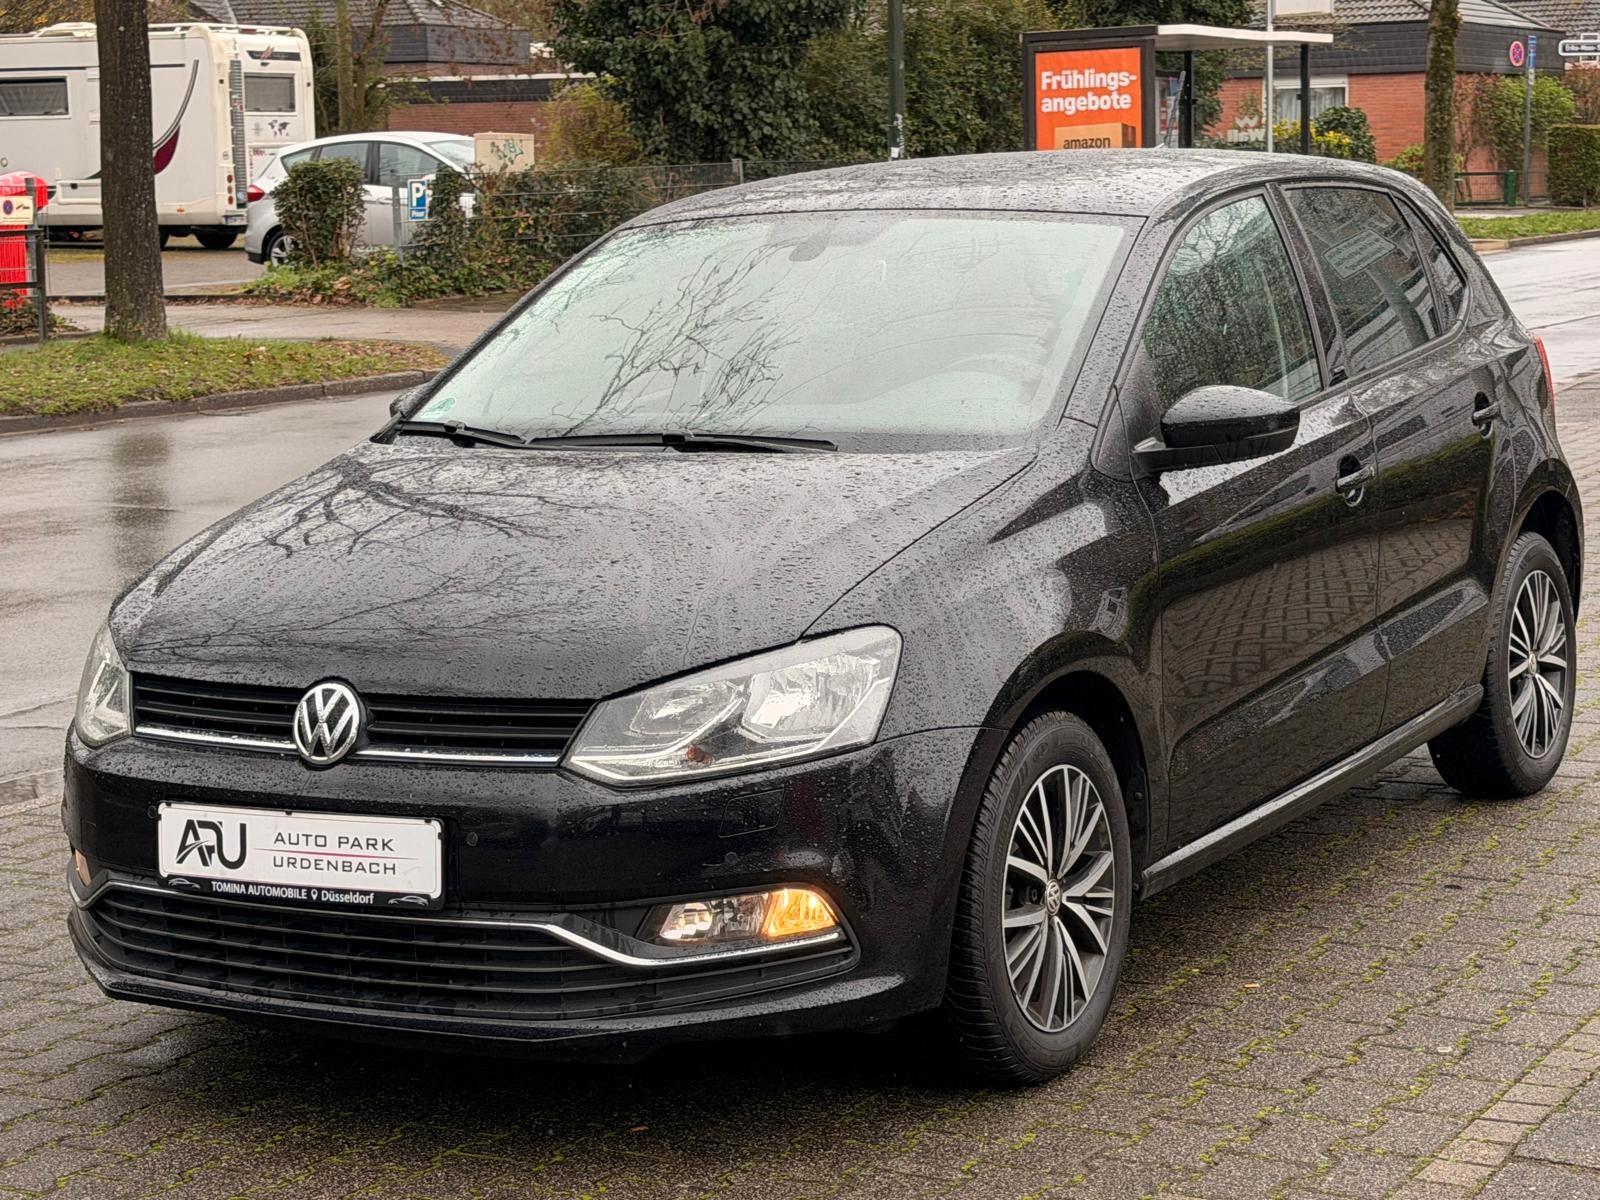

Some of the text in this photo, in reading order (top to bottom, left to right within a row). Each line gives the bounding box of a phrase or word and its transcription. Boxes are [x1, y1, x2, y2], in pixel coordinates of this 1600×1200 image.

[1041, 68, 1137, 91] Frühlings-
[1041, 91, 1132, 115] angebote
[1063, 137, 1111, 149] amazon
[411, 182, 425, 207] P
[273, 831, 395, 852] AUTO PARK
[273, 855, 396, 875] URDENBACH
[211, 881, 375, 904] TOMINA AUTOMOBILE Düsseldorf
